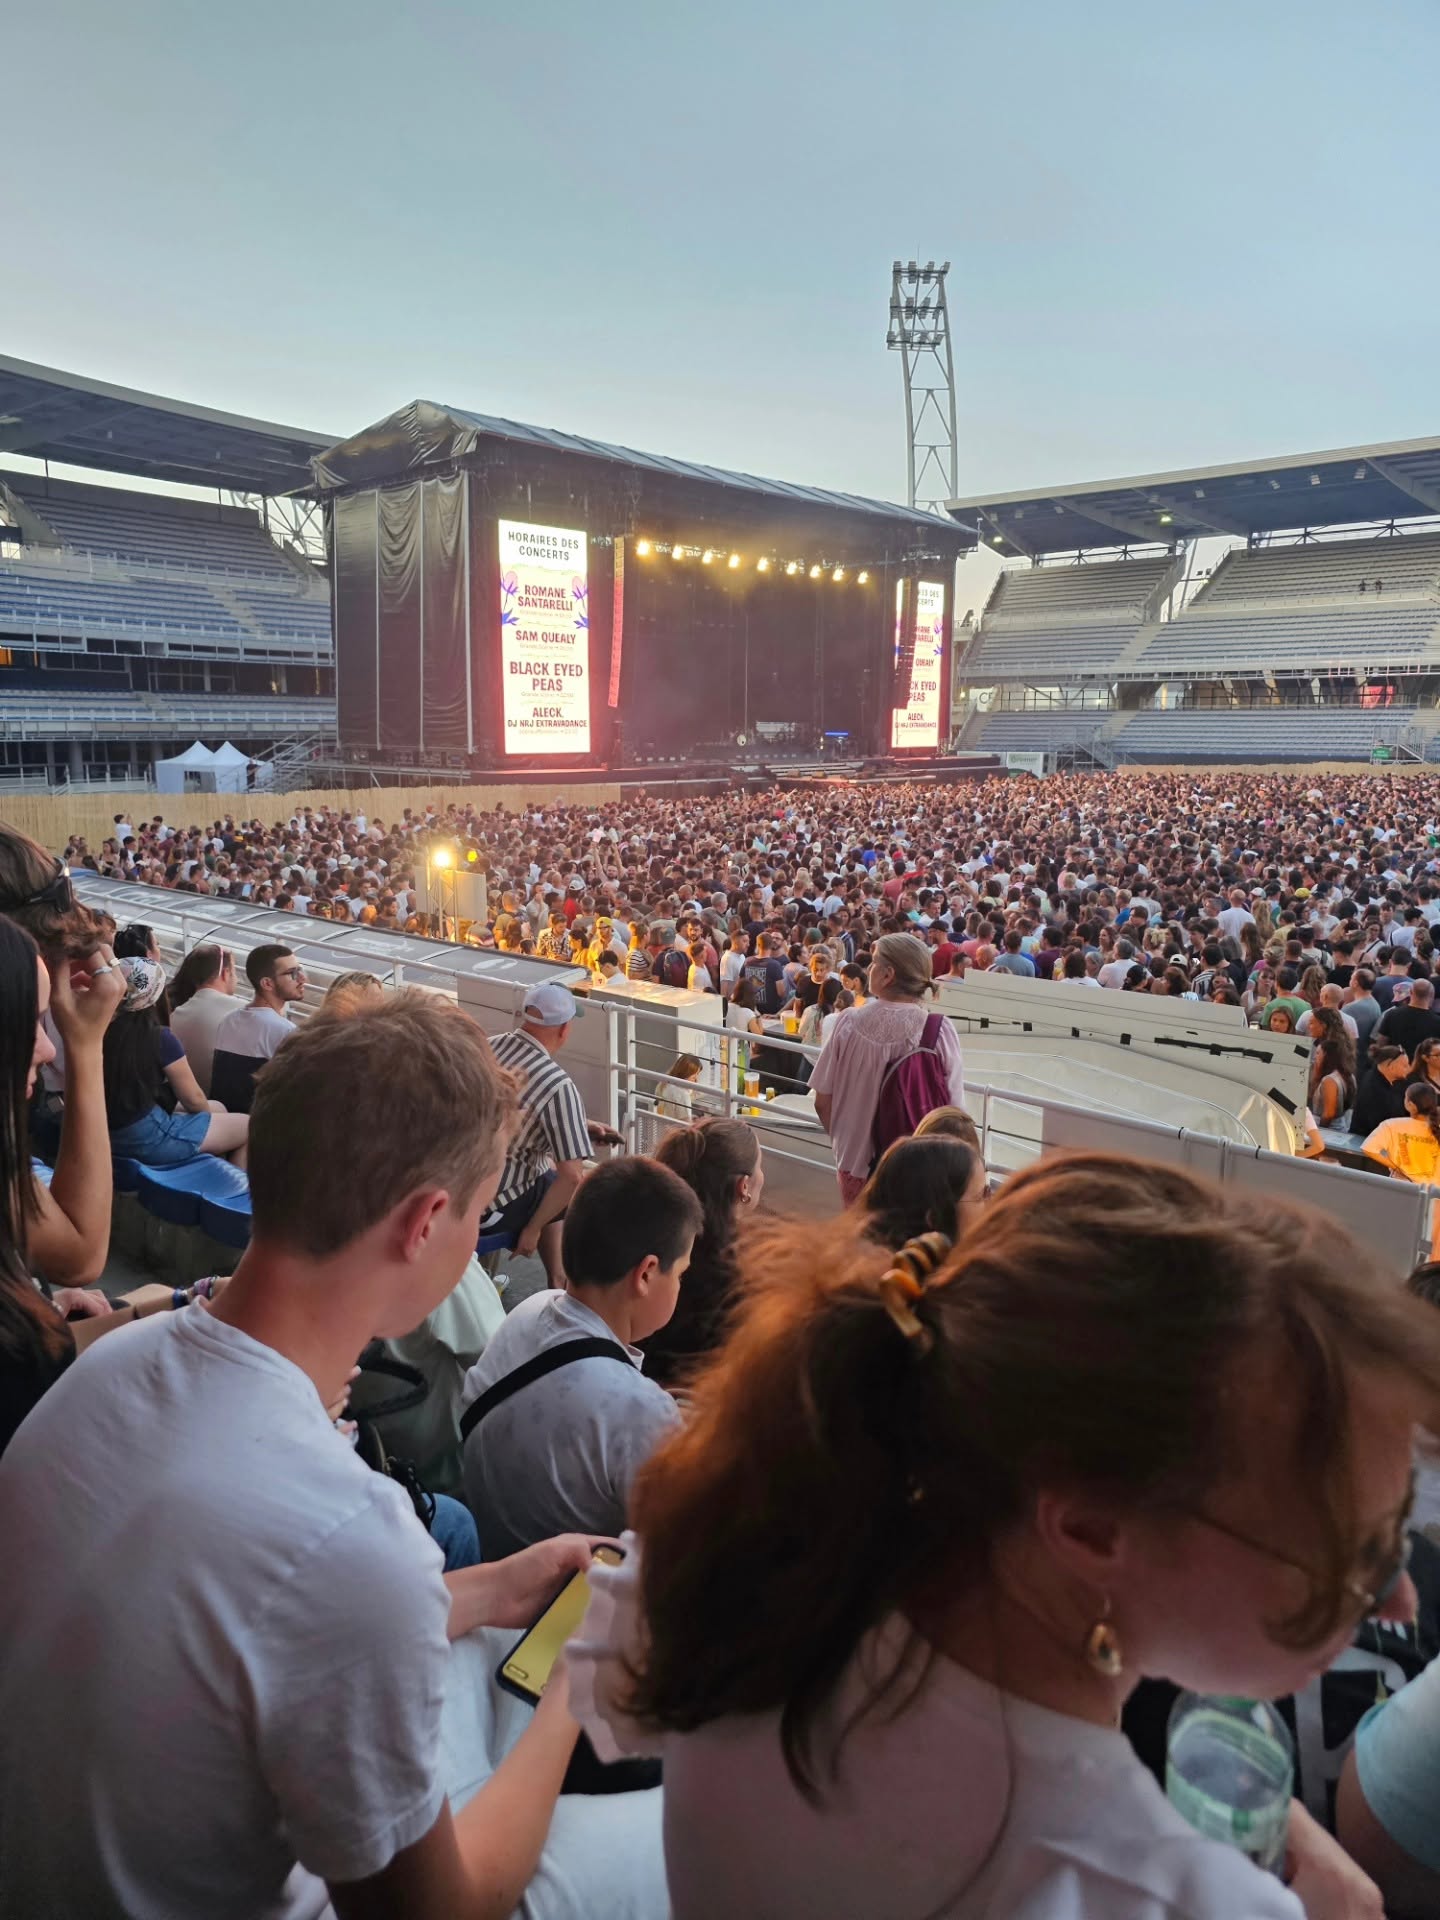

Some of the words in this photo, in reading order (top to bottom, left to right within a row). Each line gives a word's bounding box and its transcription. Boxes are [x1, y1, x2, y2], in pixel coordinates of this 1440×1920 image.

[508, 531, 558, 546] HORAIRES
[561, 538, 579, 549] DES
[519, 545, 570, 561] CONCERTS
[524, 584, 566, 598] ROMANE
[518, 596, 573, 611] SANTARELLI
[515, 630, 538, 641] SAM
[541, 632, 576, 644] QUEALY
[510, 661, 549, 675] BLACK
[554, 663, 583, 677] EYED
[532, 678, 563, 691] PEAS
[536, 720, 587, 728] EXTRAVADANCE
